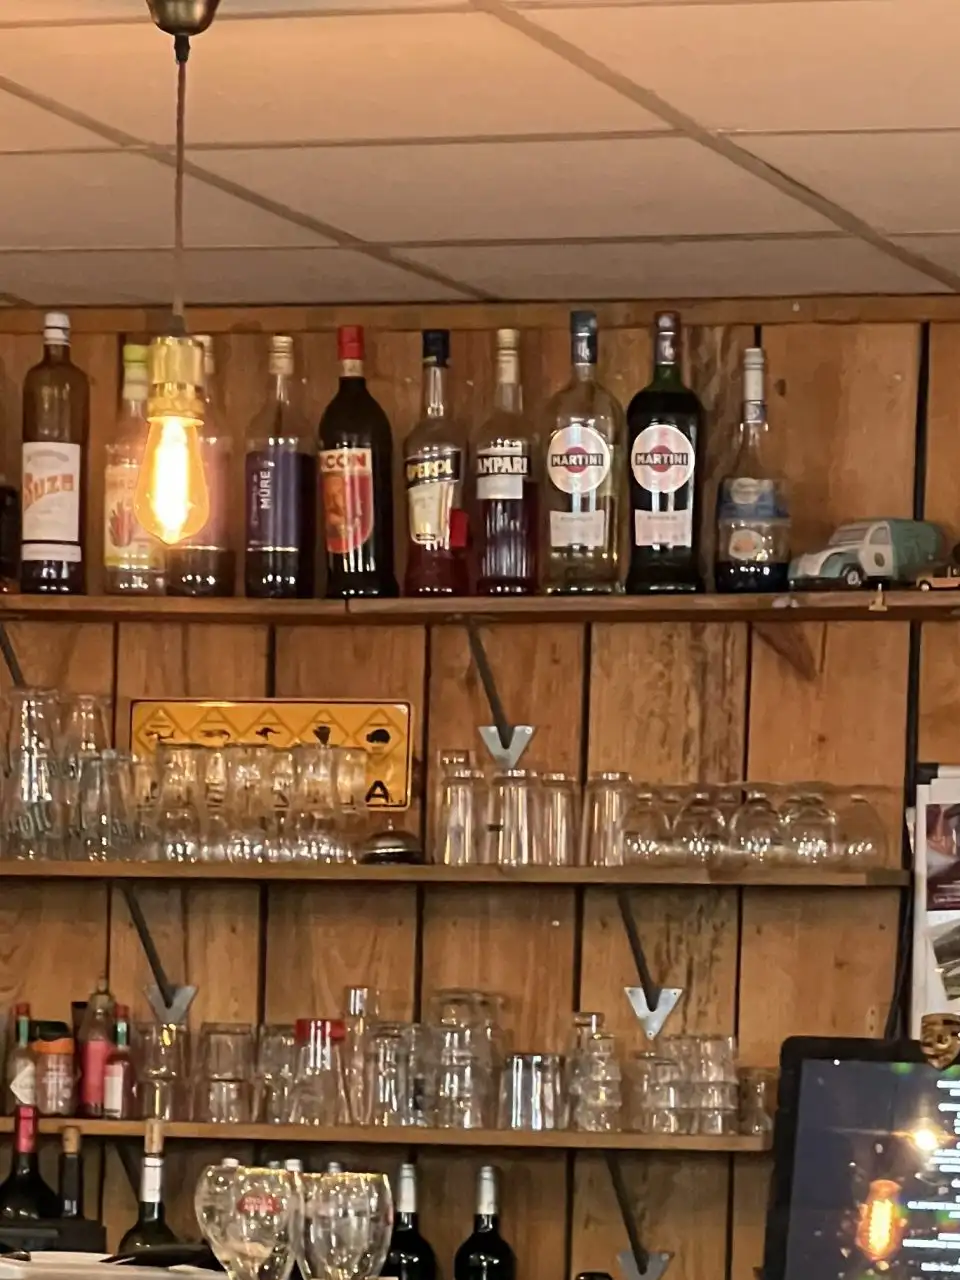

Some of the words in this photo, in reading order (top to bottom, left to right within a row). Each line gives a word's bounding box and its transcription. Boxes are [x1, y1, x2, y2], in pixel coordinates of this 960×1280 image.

[478, 456, 528, 473] AMPARI
[553, 454, 603, 466] MARTINI
[636, 453, 687, 465] MARTINI
